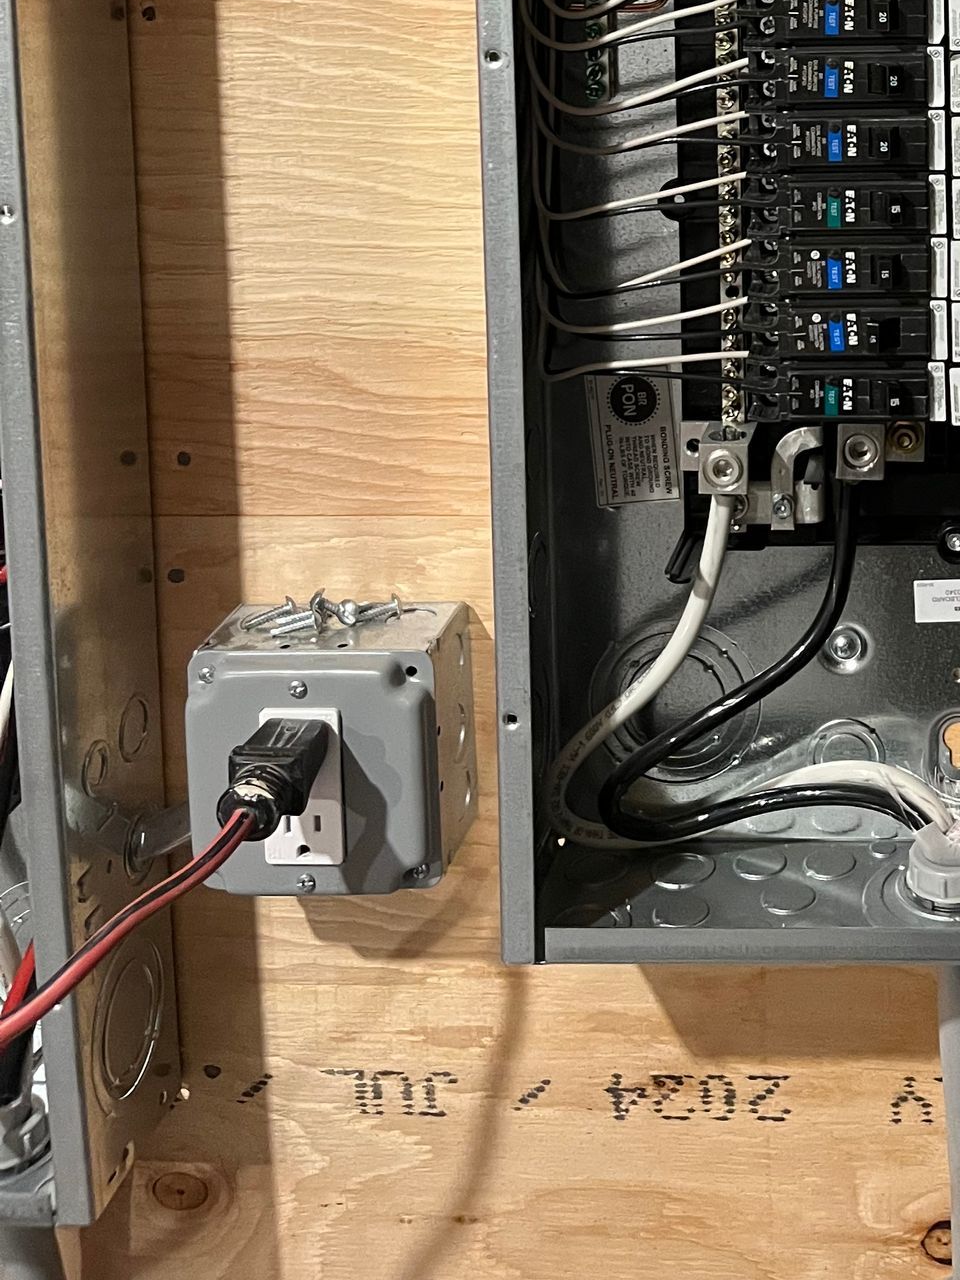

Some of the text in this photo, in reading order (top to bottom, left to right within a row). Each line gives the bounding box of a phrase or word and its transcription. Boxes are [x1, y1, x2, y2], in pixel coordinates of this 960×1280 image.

[878, 12, 887, 23] 20
[890, 75, 898, 87] 20
[880, 141, 888, 152] 20
[891, 205, 901, 214] 15
[881, 270, 889, 279] 15
[620, 384, 636, 416] PON
[637, 392, 647, 406] BR
[890, 398, 900, 407] 15
[660, 426, 672, 495] BONDING SCREW
[608, 462, 618, 500] NEUTRAL
[319, 1069, 458, 1118] JUL
[604, 1073, 792, 1124] 2024
